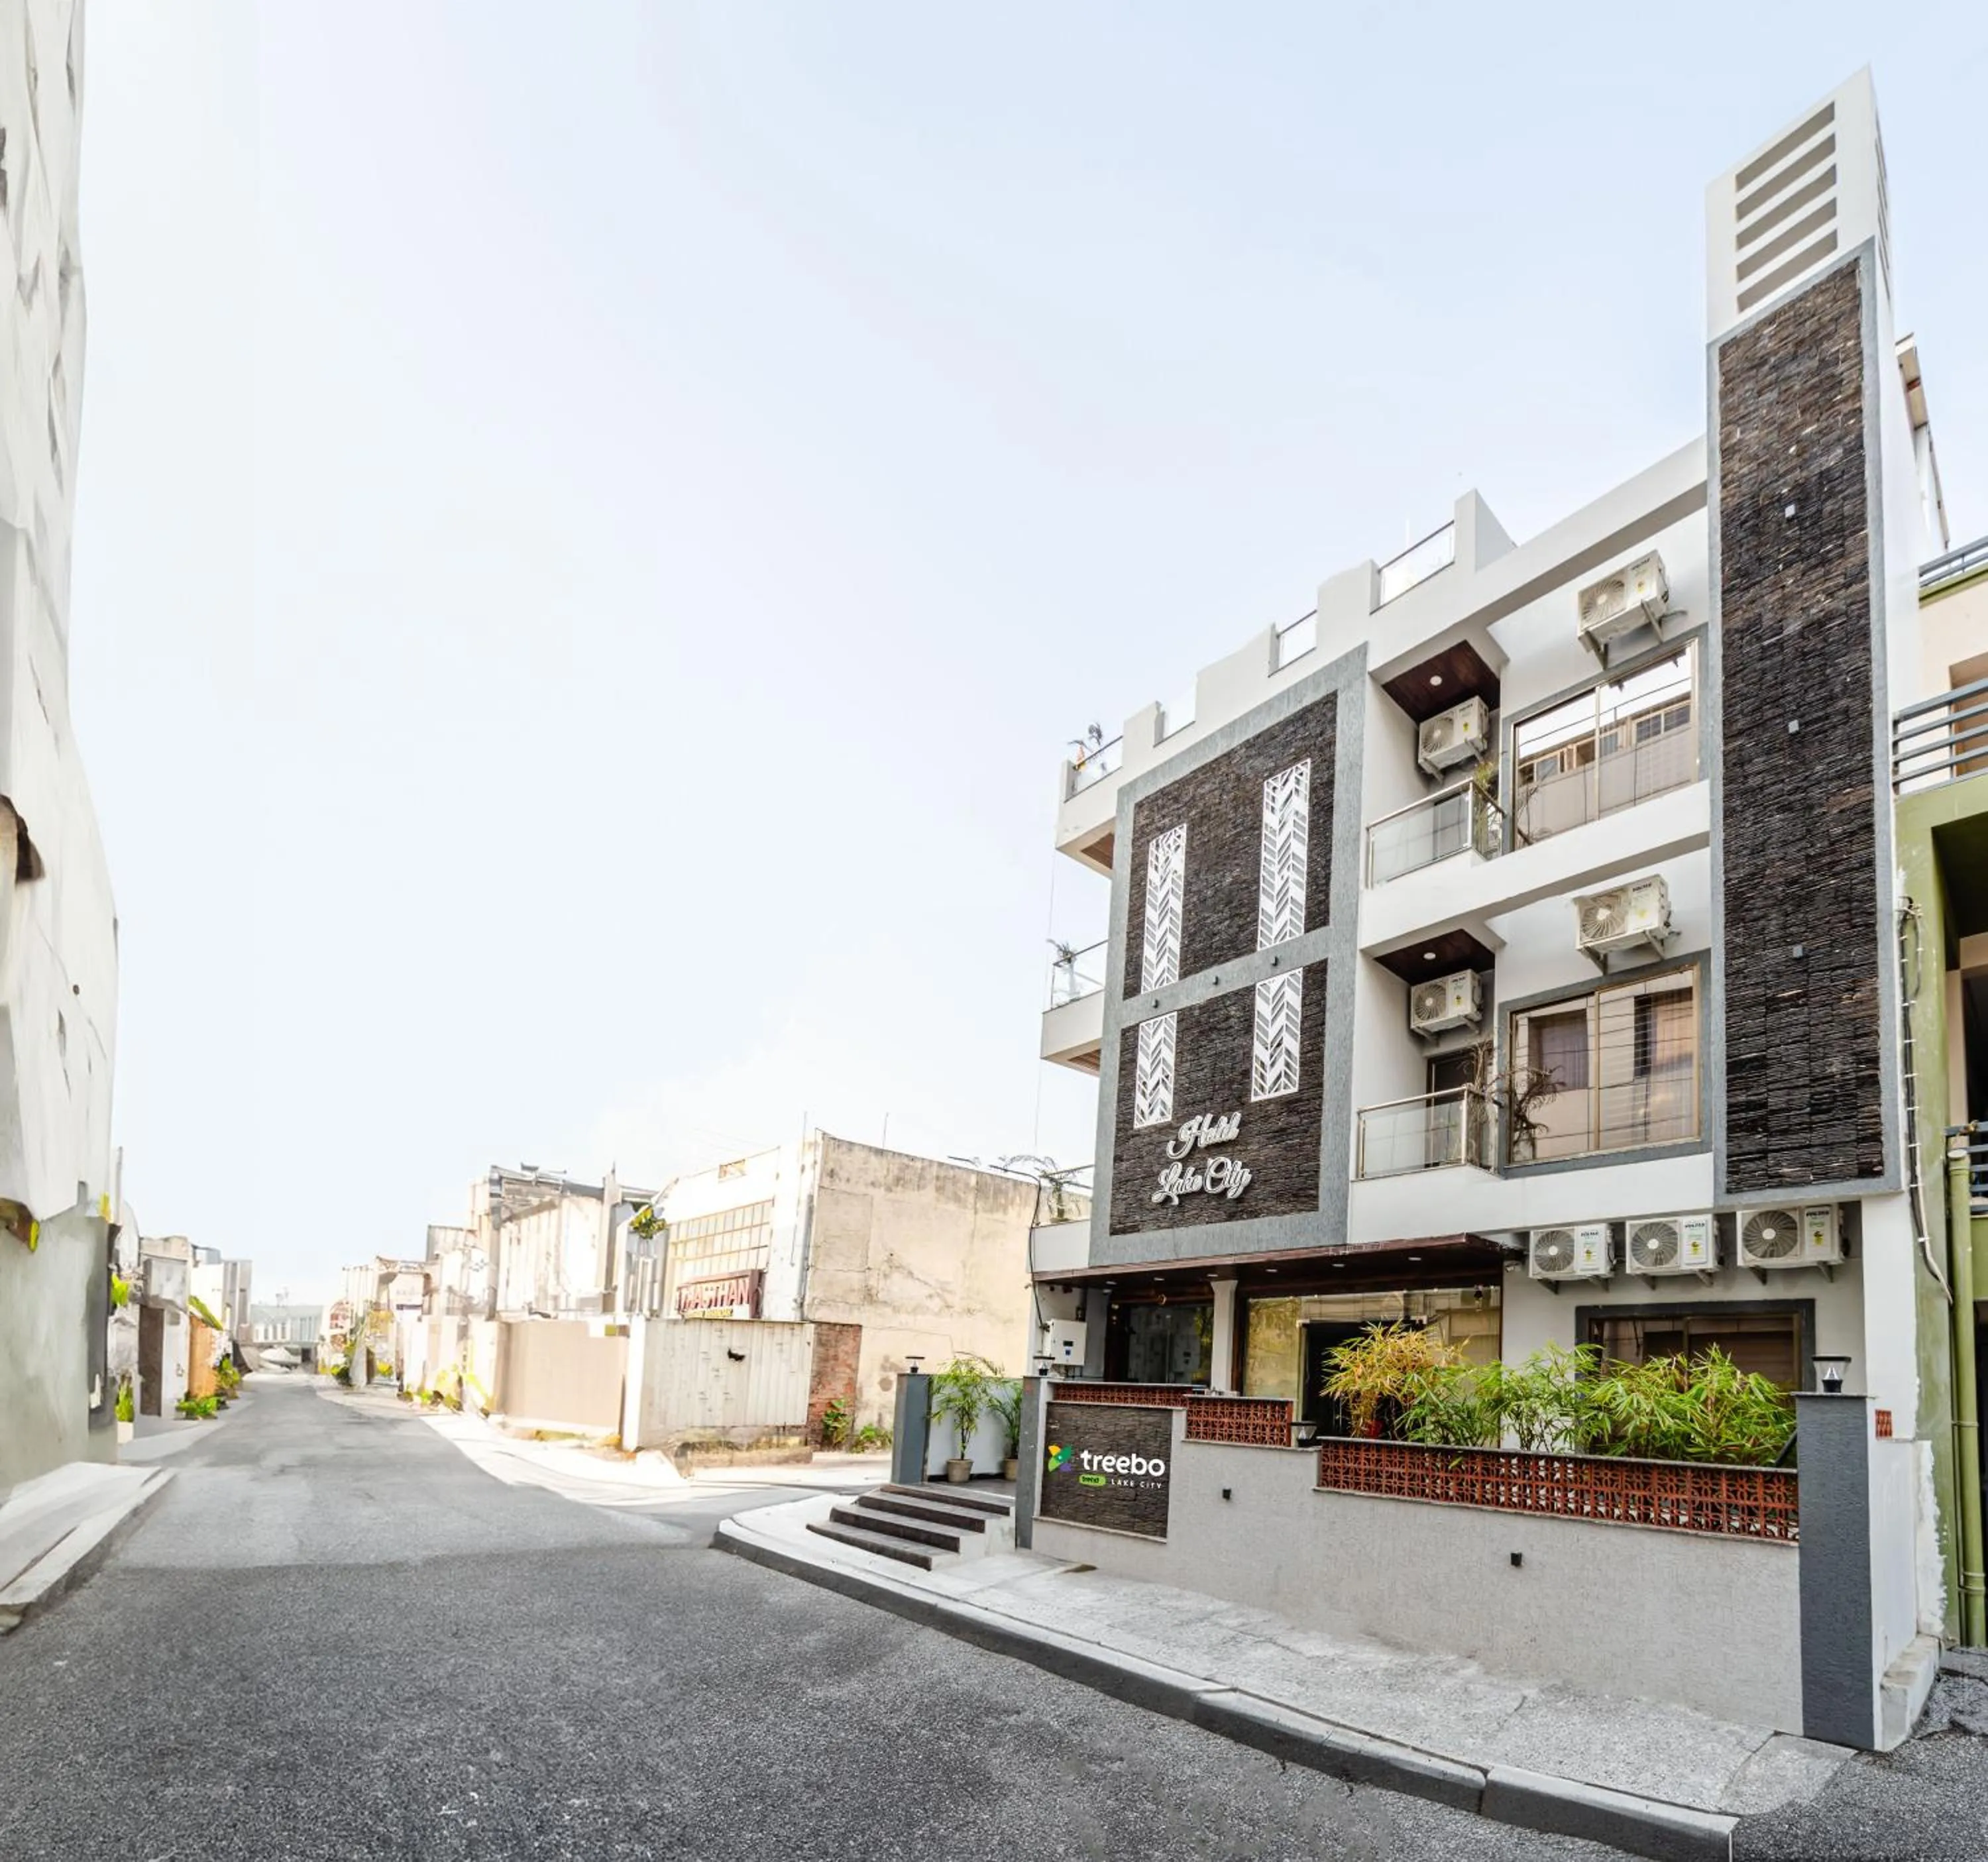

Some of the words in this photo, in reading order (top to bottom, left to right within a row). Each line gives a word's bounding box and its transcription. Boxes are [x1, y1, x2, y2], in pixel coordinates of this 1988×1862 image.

[1166, 1112, 1242, 1159] Hotel
[1151, 1162, 1203, 1205] Lake
[1203, 1156, 1253, 1199] City
[1079, 1450, 1166, 1476] treebo
[1111, 1478, 1135, 1488] LAKE
